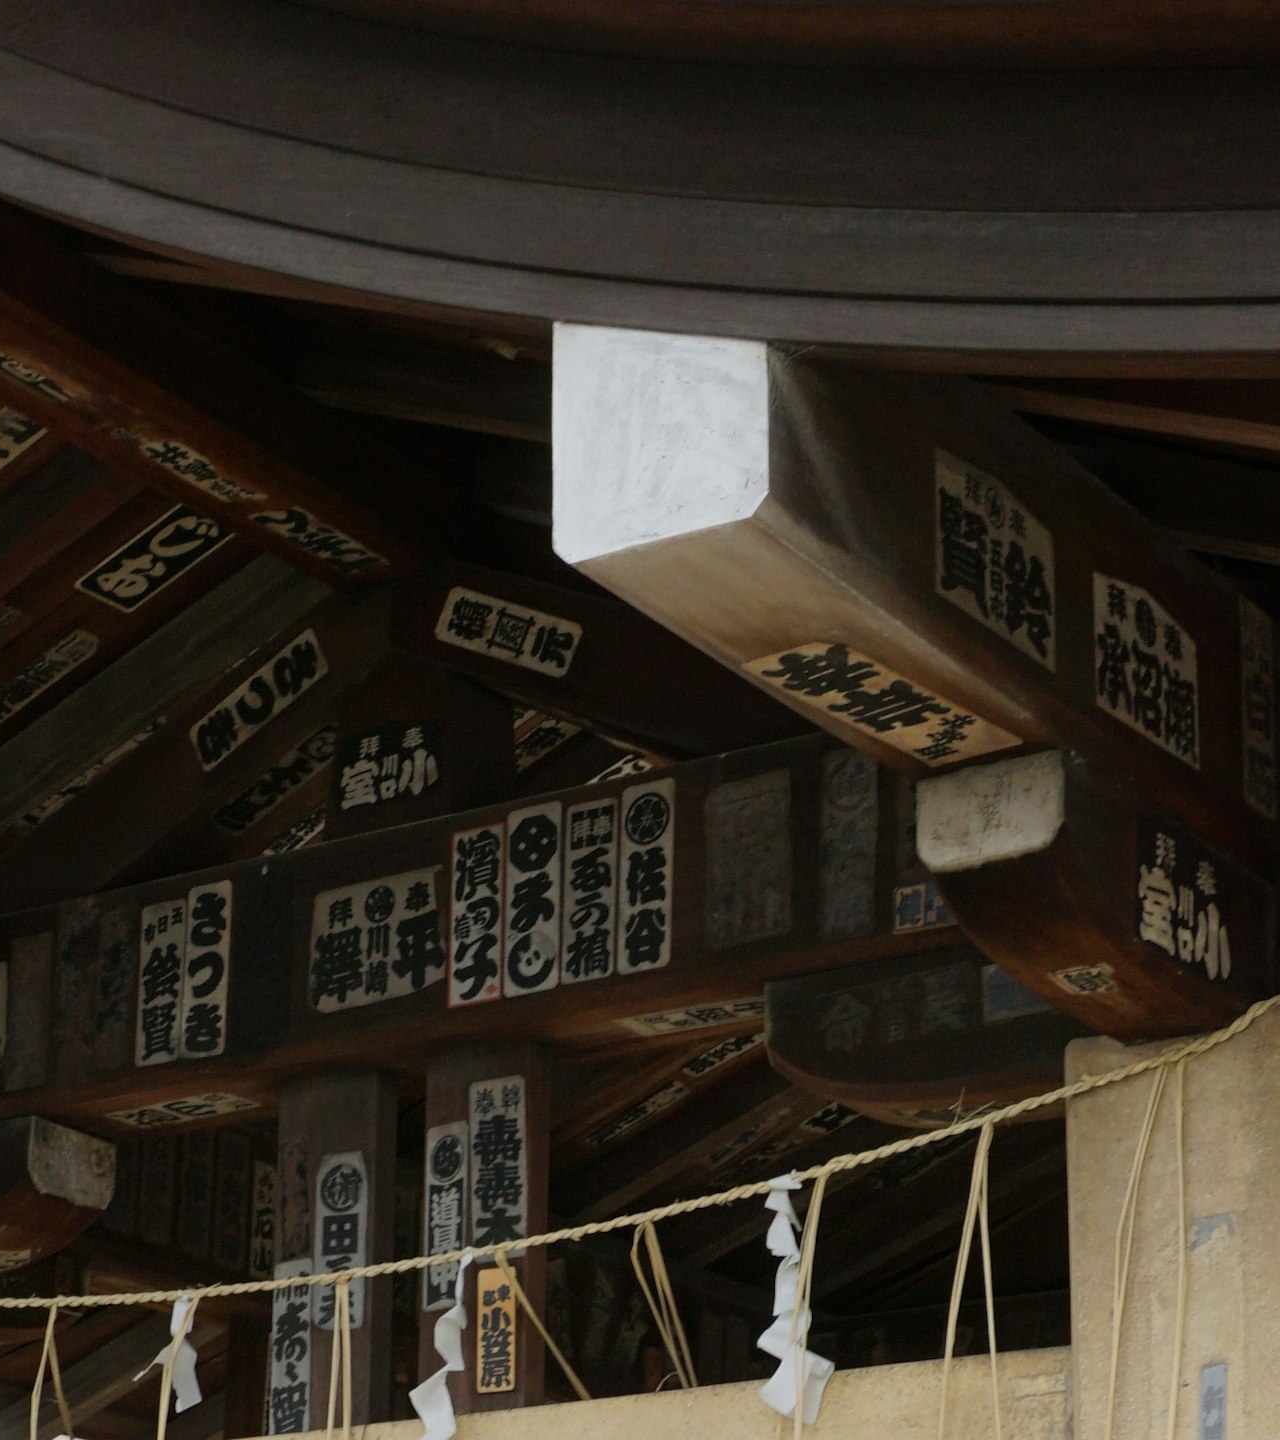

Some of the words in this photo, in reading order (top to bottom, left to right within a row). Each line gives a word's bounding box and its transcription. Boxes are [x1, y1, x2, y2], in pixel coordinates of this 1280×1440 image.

[359, 726, 426, 758] 奉拝
[143, 906, 184, 946] 五日市
[328, 882, 431, 930] 奉拝
[186, 892, 227, 1053] さつき
[365, 928, 390, 998] 川崎
[480, 1306, 513, 1388] 小笠原
